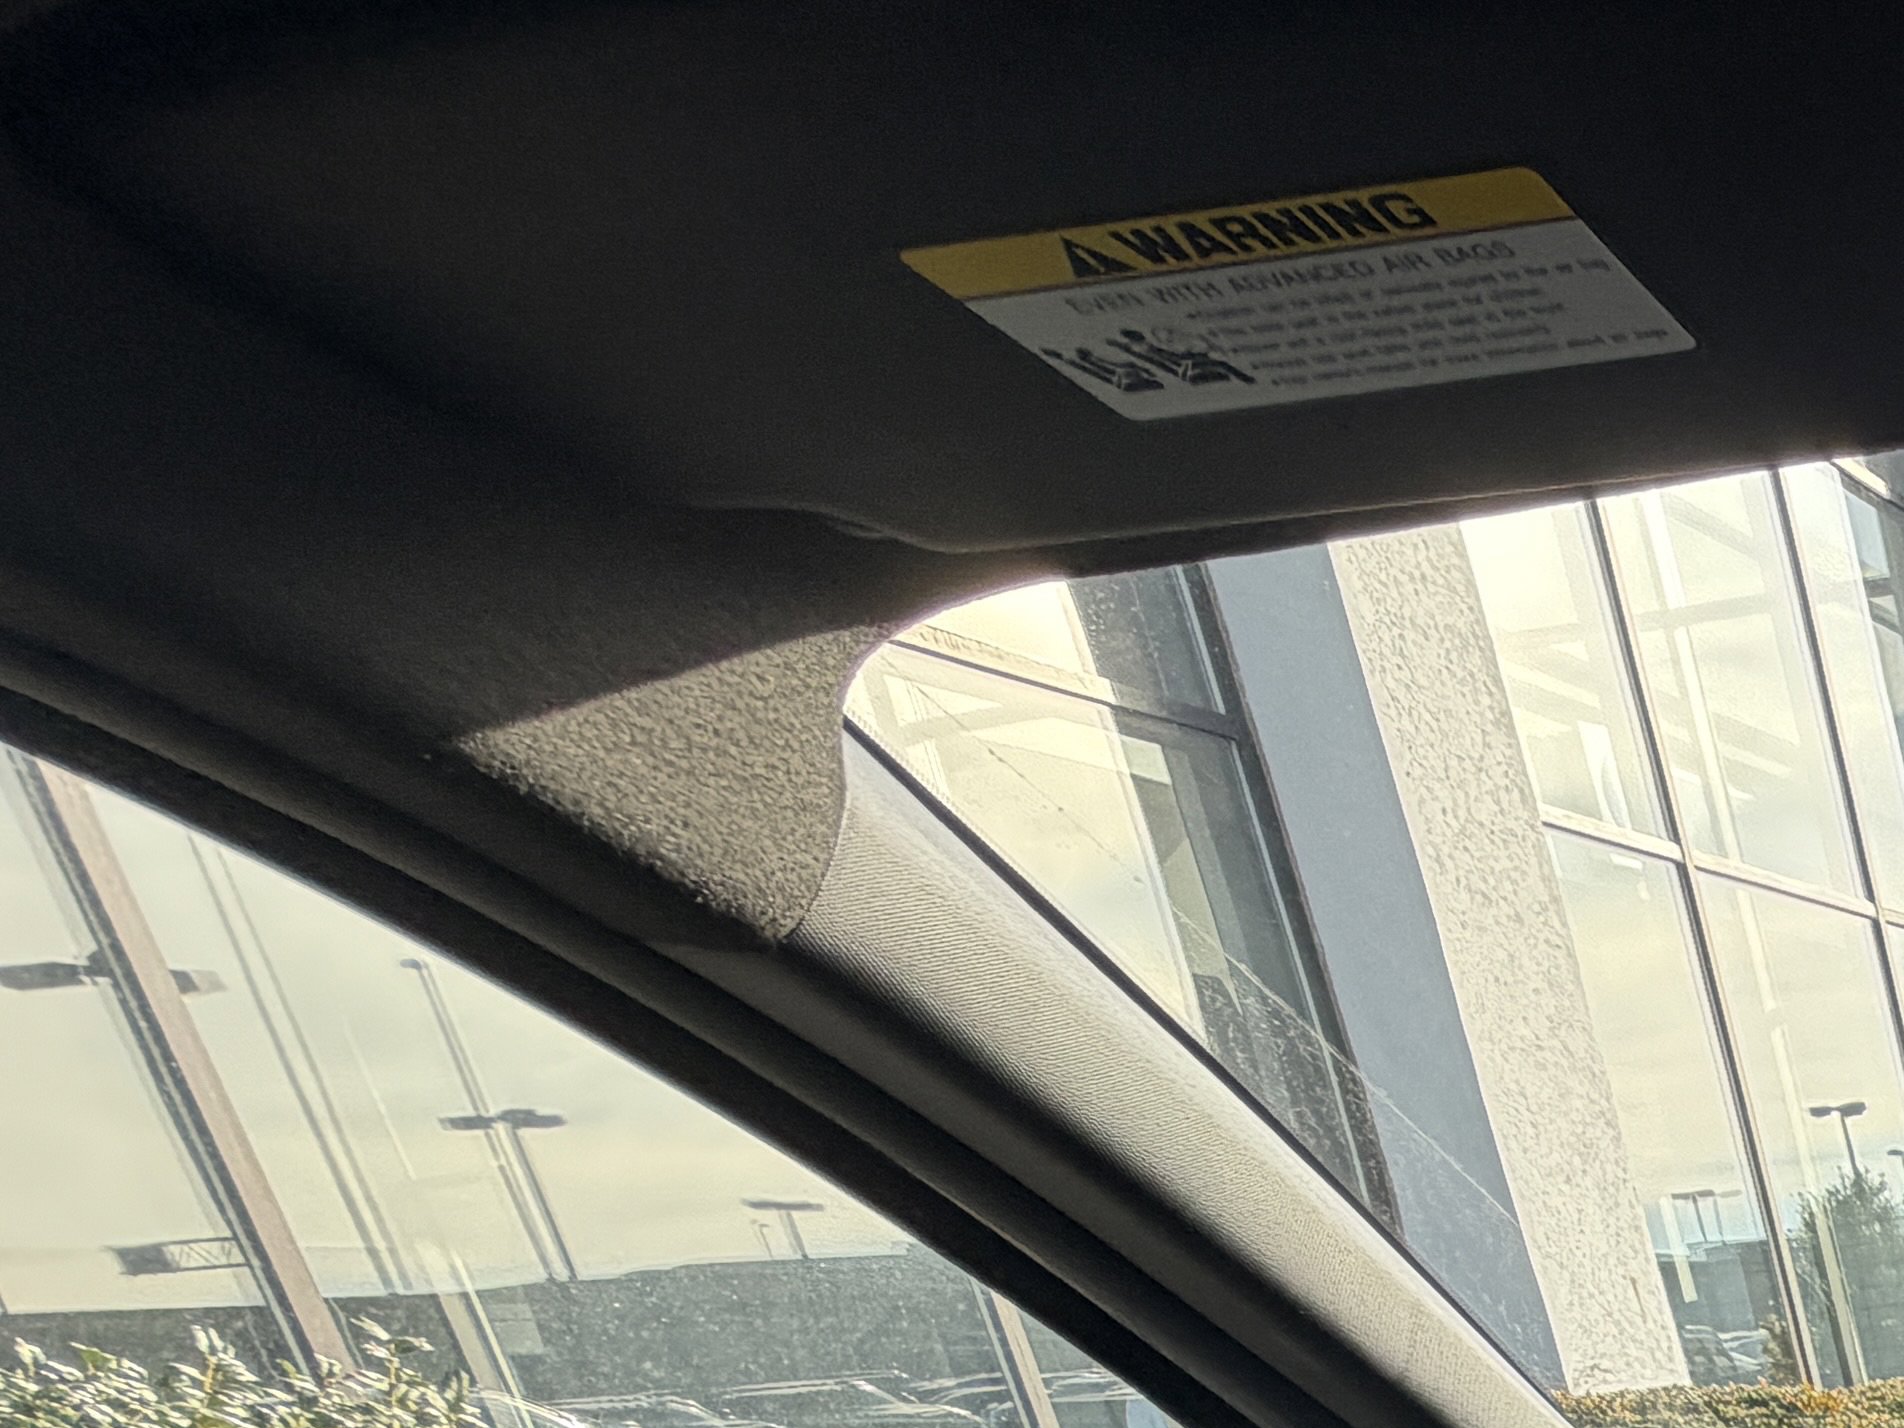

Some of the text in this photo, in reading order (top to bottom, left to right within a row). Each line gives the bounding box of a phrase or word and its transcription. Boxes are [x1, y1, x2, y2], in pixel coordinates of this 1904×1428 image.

[1108, 192, 1438, 264] WARNING
[1065, 240, 1516, 315] EVEN WITH ADVANCED AIR BAGS
